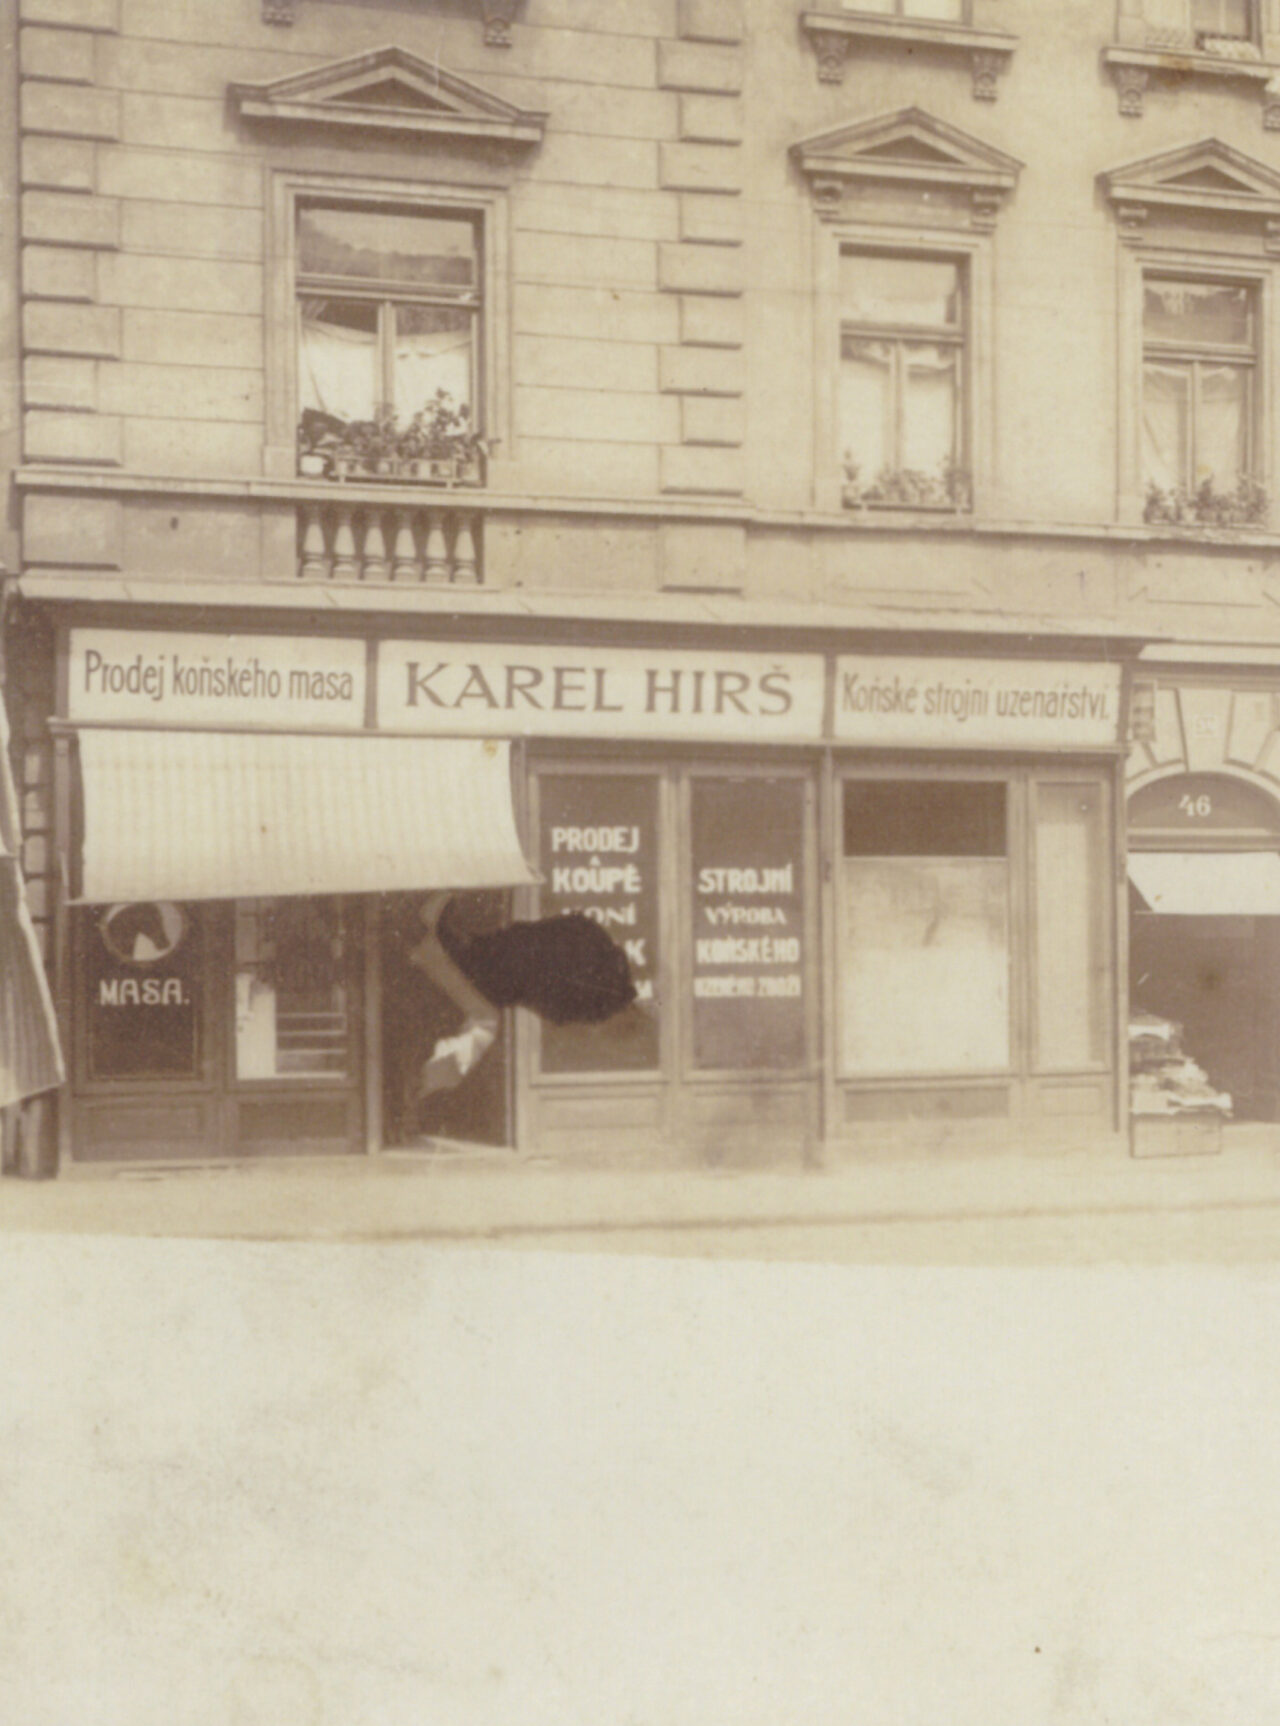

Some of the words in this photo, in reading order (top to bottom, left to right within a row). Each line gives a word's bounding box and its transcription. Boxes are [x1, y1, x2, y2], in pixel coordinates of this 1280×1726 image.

[85, 649, 165, 701] Prodej
[172, 656, 282, 700] koňského
[288, 670, 353, 702] masa
[405, 661, 623, 712] KAREL
[645, 665, 794, 716] HIRŠ
[923, 678, 989, 722] strojní
[1178, 794, 1212, 817] 46
[552, 825, 641, 852] PRODEJ
[552, 863, 642, 894] KOUPĚ
[697, 861, 794, 895] STROJNÍ
[703, 899, 788, 926] VÝROBA
[99, 977, 191, 1006] MASA.
